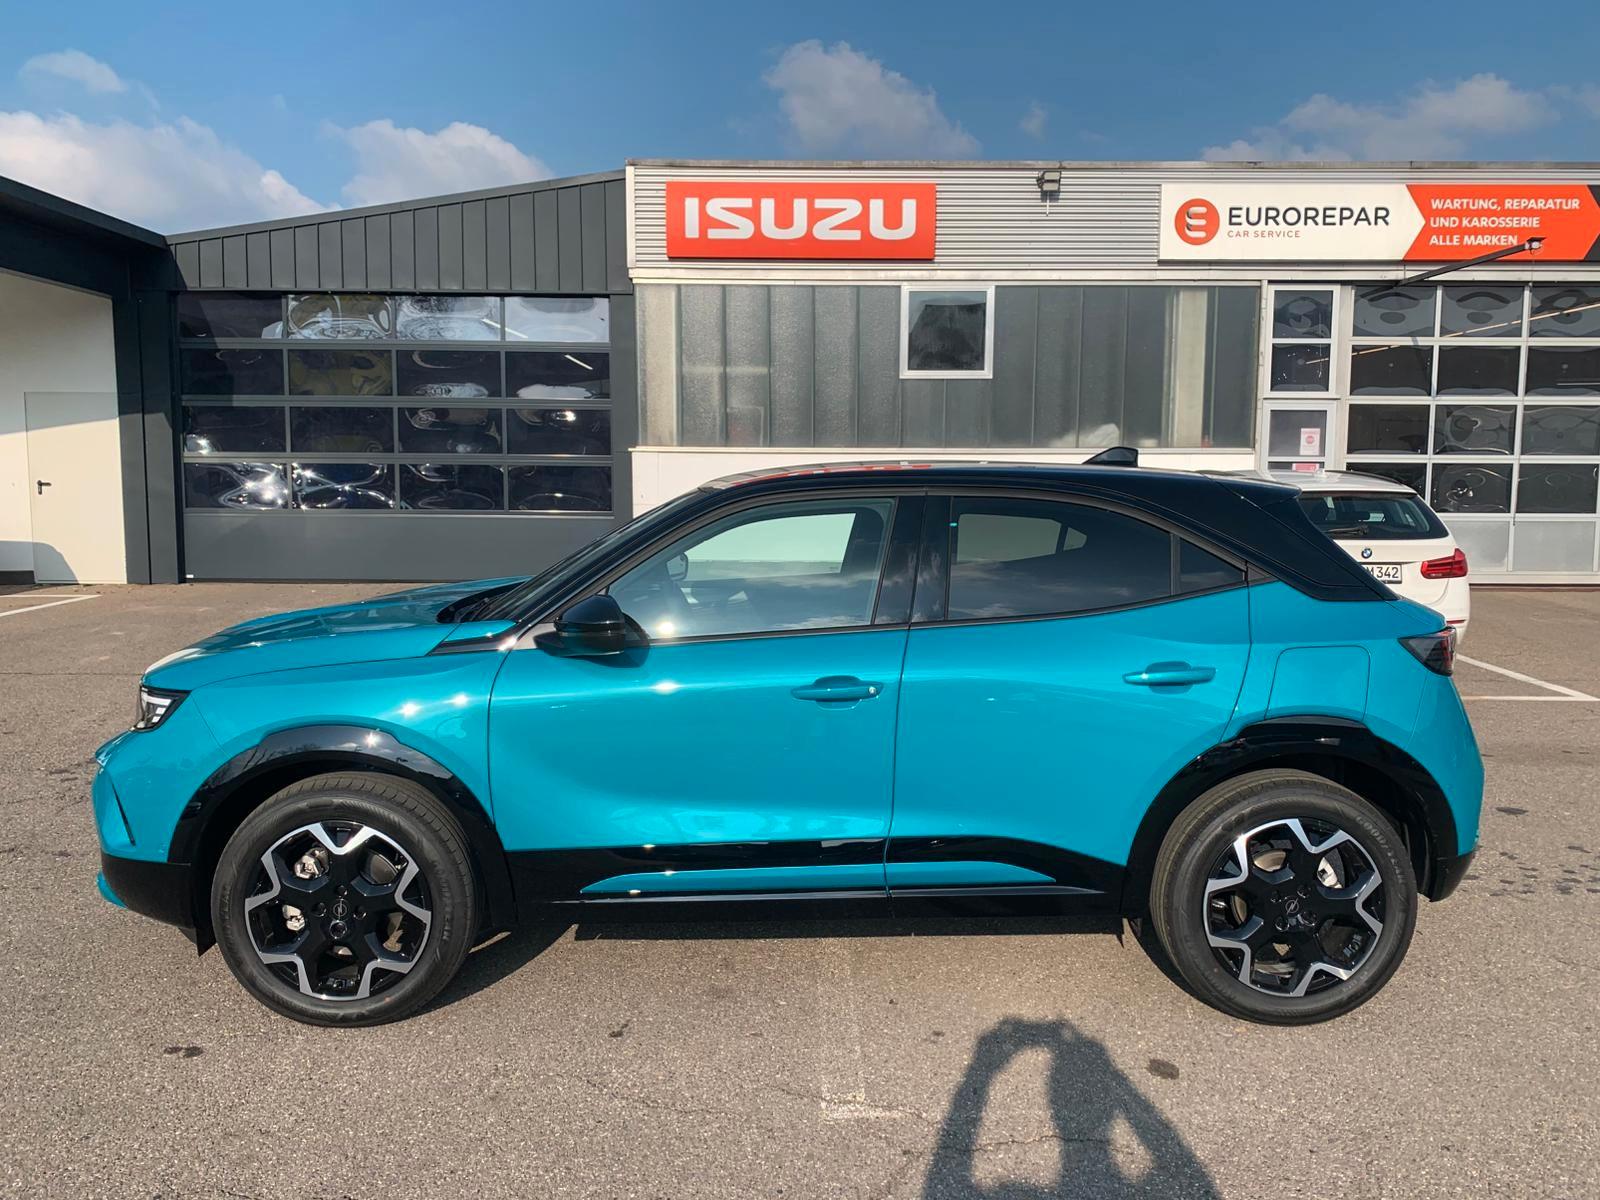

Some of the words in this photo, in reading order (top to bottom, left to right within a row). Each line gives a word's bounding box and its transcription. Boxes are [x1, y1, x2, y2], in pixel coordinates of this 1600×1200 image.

[1430, 198, 1502, 212] WARTUNG,
[1504, 198, 1580, 211] REPARATUR
[684, 197, 918, 241] ISUZU
[1228, 206, 1391, 227] EUROREPAR
[1430, 216, 1460, 228] UND
[1461, 216, 1540, 228] KAROSSERIE
[1226, 230, 1250, 239] CAR
[1253, 230, 1301, 239] SERVICE
[1429, 234, 1460, 246] ALLE
[1462, 234, 1518, 246] MARKEN
